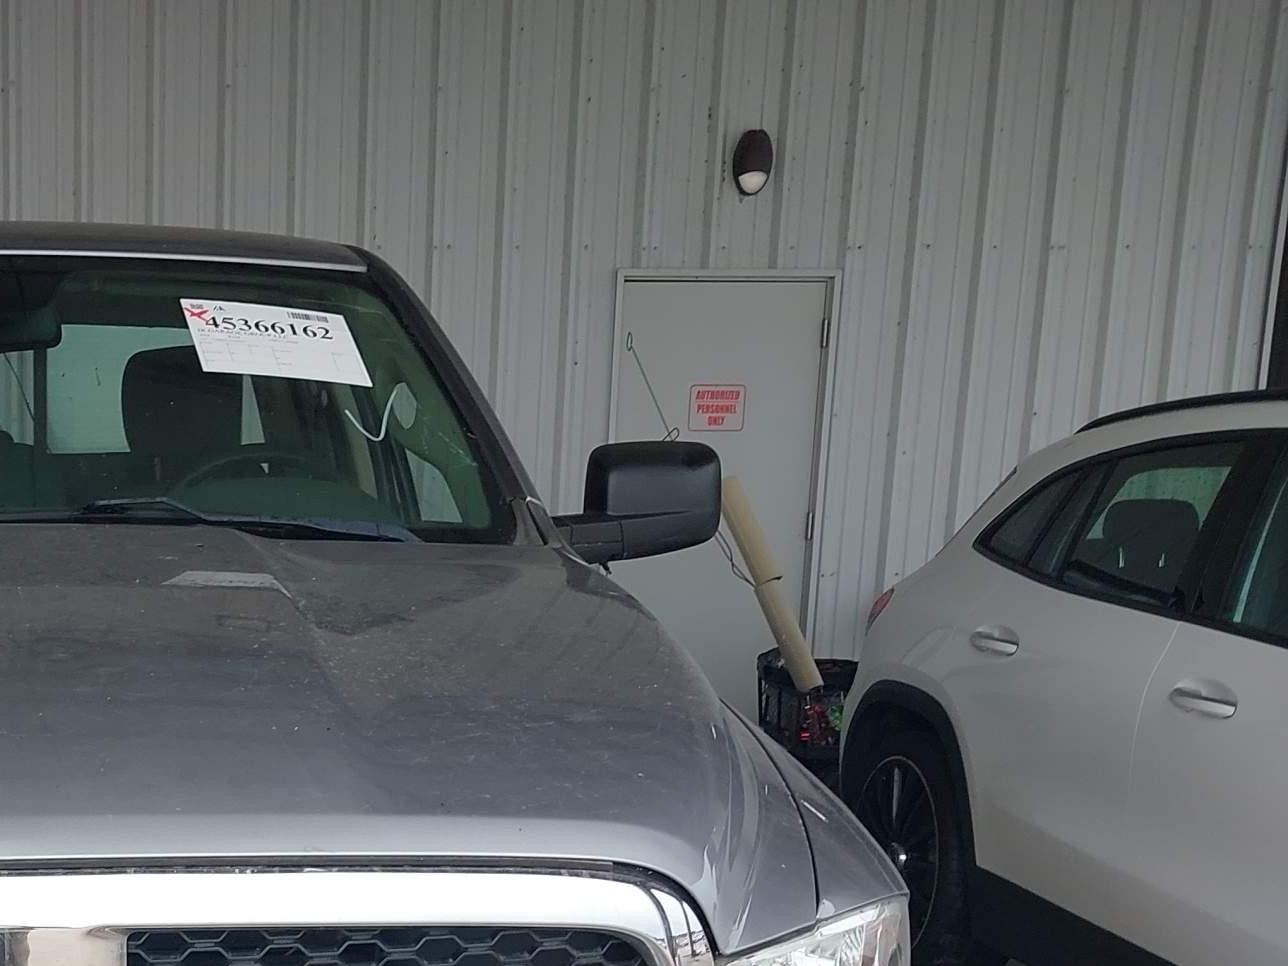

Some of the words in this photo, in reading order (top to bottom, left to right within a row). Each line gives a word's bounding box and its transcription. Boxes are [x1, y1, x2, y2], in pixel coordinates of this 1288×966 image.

[205, 315, 334, 340] 45366162
[696, 390, 740, 400] AUTHORIZED
[697, 404, 736, 414] PERSONNEL
[708, 415, 725, 426] ONLY
